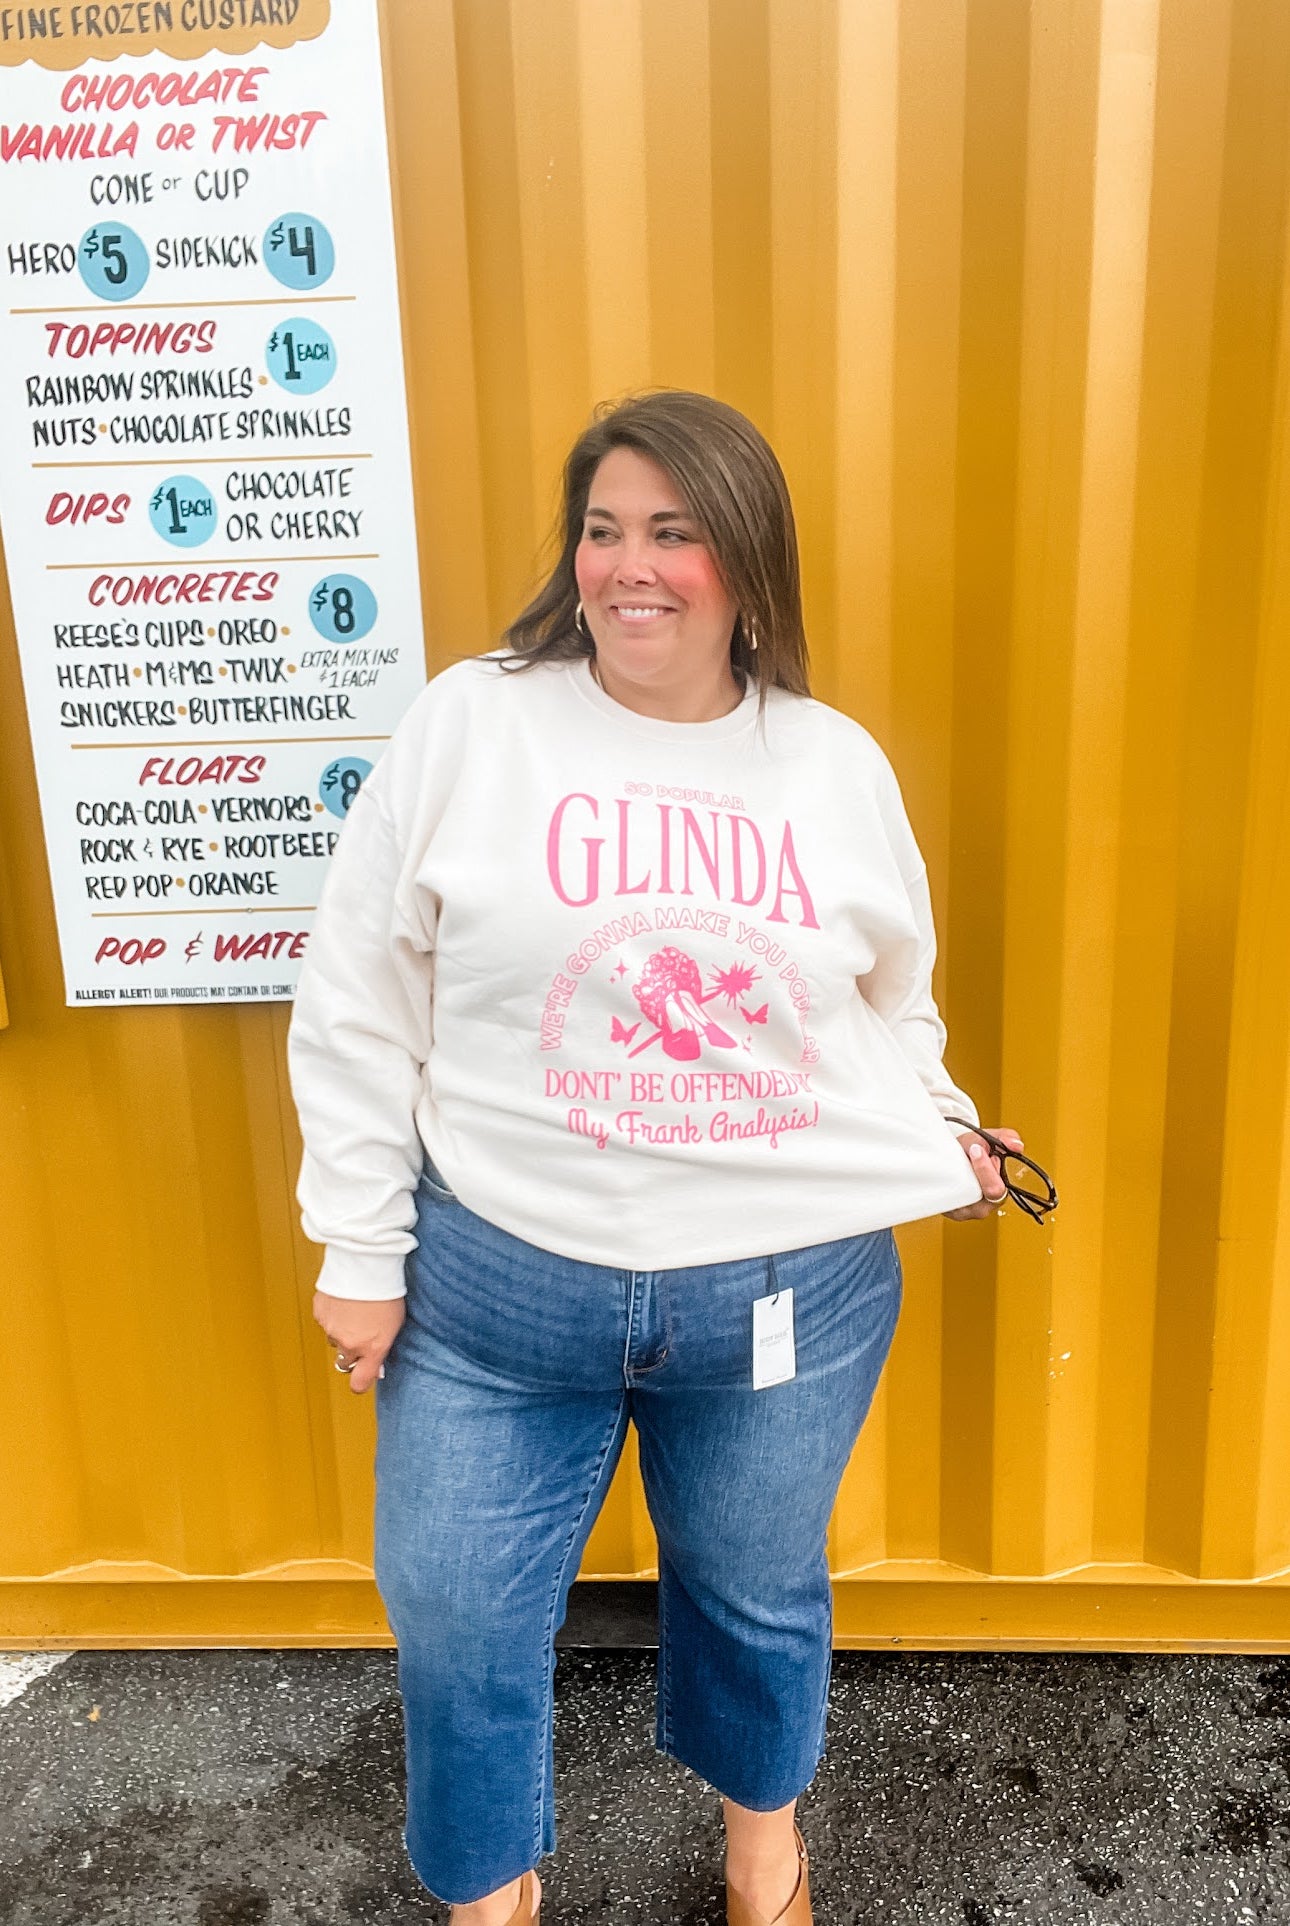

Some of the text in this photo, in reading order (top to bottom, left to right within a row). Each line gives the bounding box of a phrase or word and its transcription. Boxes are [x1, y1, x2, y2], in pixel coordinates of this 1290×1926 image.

[1, 0, 299, 40] FINE FROZEN CUSTARD
[61, 66, 270, 113] CHOCOLATE
[0, 111, 328, 163] VANILLA OR TWIST
[90, 168, 249, 206] CONE or CUP
[8, 222, 316, 285] HERO $5 SIDEKICK $4
[45, 320, 217, 359] TOPPINGS
[297, 343, 329, 362] EACH
[26, 367, 253, 408] RAINBOW SPRINKLES
[33, 407, 351, 448] NUTS CHOCOLATE SPRINKLES
[226, 467, 354, 501] CHOCOLATE
[45, 492, 131, 526] DIPS
[181, 498, 212, 518] EACH
[226, 509, 363, 542] OR CHERRY
[88, 571, 279, 607] CONCRETES
[313, 582, 355, 634] $8
[53, 618, 277, 648] REESE'S CUPS OREO
[57, 663, 130, 689] HEATH
[224, 657, 288, 683] TWIX
[301, 649, 339, 668] EXTRA
[341, 670, 379, 687] EACH
[61, 694, 356, 728] SNICKERS BUTTERFINGER
[139, 755, 266, 786] FLOATS
[624, 781, 653, 796] SO
[76, 796, 312, 826] COCA-COLA VERNORS
[81, 838, 138, 864] ROCK
[161, 837, 205, 861] RYE
[546, 793, 820, 930] GLINDA
[86, 871, 280, 900] RED POP ORANGE
[95, 931, 310, 965] POP & WATE
[75, 989, 116, 1000] ALLERGY
[119, 988, 152, 999] ALERT!
[154, 988, 168, 998] OUR
[171, 986, 208, 998] PRODUCTS
[211, 986, 225, 997] MAY
[228, 985, 258, 997] CONTAIN
[261, 985, 270, 996] OR
[273, 985, 293, 995] COME
[540, 973, 578, 1050] WE'RE
[566, 912, 652, 975] GONNA
[655, 907, 730, 937] MAKE
[737, 922, 789, 967] YOU
[631, 1073, 663, 1102] BE
[567, 1101, 819, 1150] My Frank Analysis!
